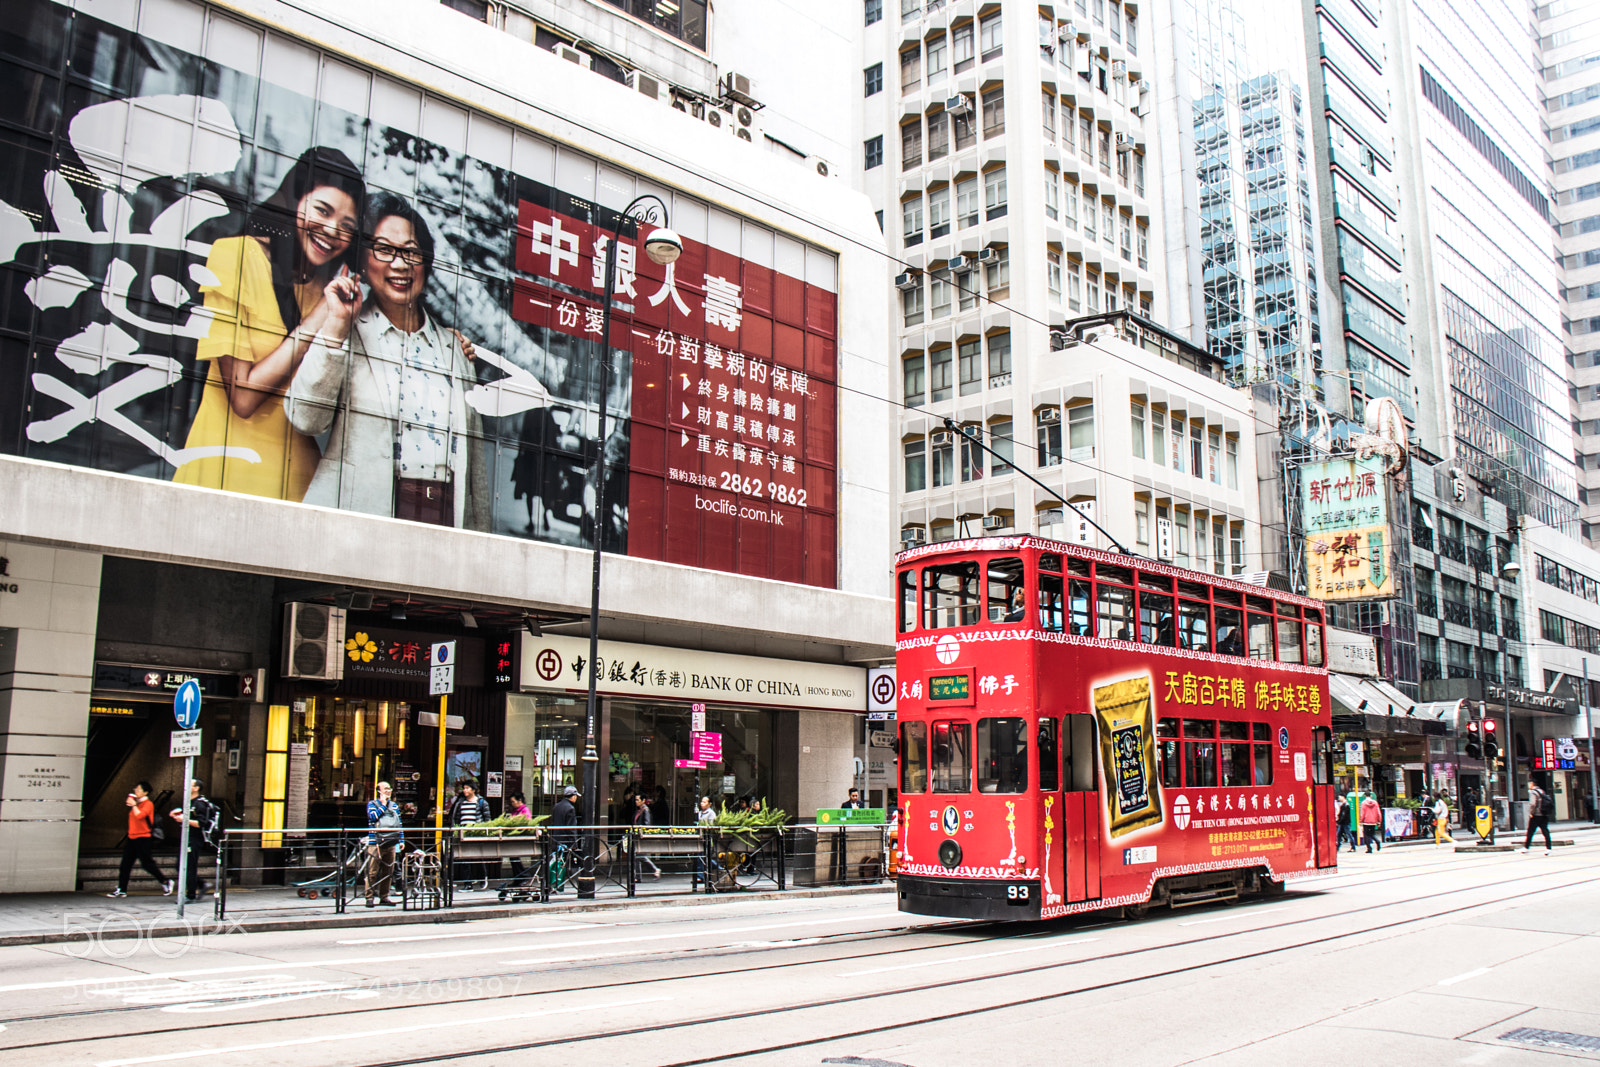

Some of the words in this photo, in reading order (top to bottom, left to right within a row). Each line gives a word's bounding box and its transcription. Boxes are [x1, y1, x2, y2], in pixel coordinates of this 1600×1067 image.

[532, 216, 743, 331] 中銀人壽
[530, 298, 604, 336] 一份愛
[631, 328, 809, 396] 一份對摯親的保障
[697, 378, 797, 422] 終身壽險籌劃
[696, 405, 797, 447] 財富累積傳承
[696, 434, 797, 475] 重疾醫療守護
[668, 467, 717, 488] 預約及投保
[720, 471, 763, 497] 2862
[767, 482, 808, 508] 9862
[1309, 471, 1378, 504] 新竹源
[695, 494, 785, 526] boclife.com.hk
[497, 641, 510, 672] 浦和
[352, 665, 374, 673] URAWA
[375, 667, 405, 675] JAPANESE
[495, 675, 511, 683] うらわ
[932, 677, 955, 686] Kennedy
[691, 674, 731, 691] BANK
[735, 678, 753, 692] OF
[757, 680, 801, 696] CHINA
[899, 679, 923, 701] 天廚
[978, 674, 1020, 696] 佛手
[1164, 671, 1246, 709] 天廚百年情
[1254, 680, 1322, 715] 佛手味至尊
[27, 780, 62, 788] 244-248
[1195, 793, 1296, 814] 香港天廚有限公司
[1191, 819, 1203, 829] THE
[1203, 819, 1216, 828] TIEN
[1216, 818, 1227, 827] CHU
[1227, 818, 1244, 827] (HONG
[1244, 817, 1259, 826] KONG)
[1259, 815, 1281, 825] COMPANY
[1281, 813, 1300, 823] LIMITED
[1249, 843, 1284, 852] www.tienchu.com
[1007, 885, 1029, 899] 93
